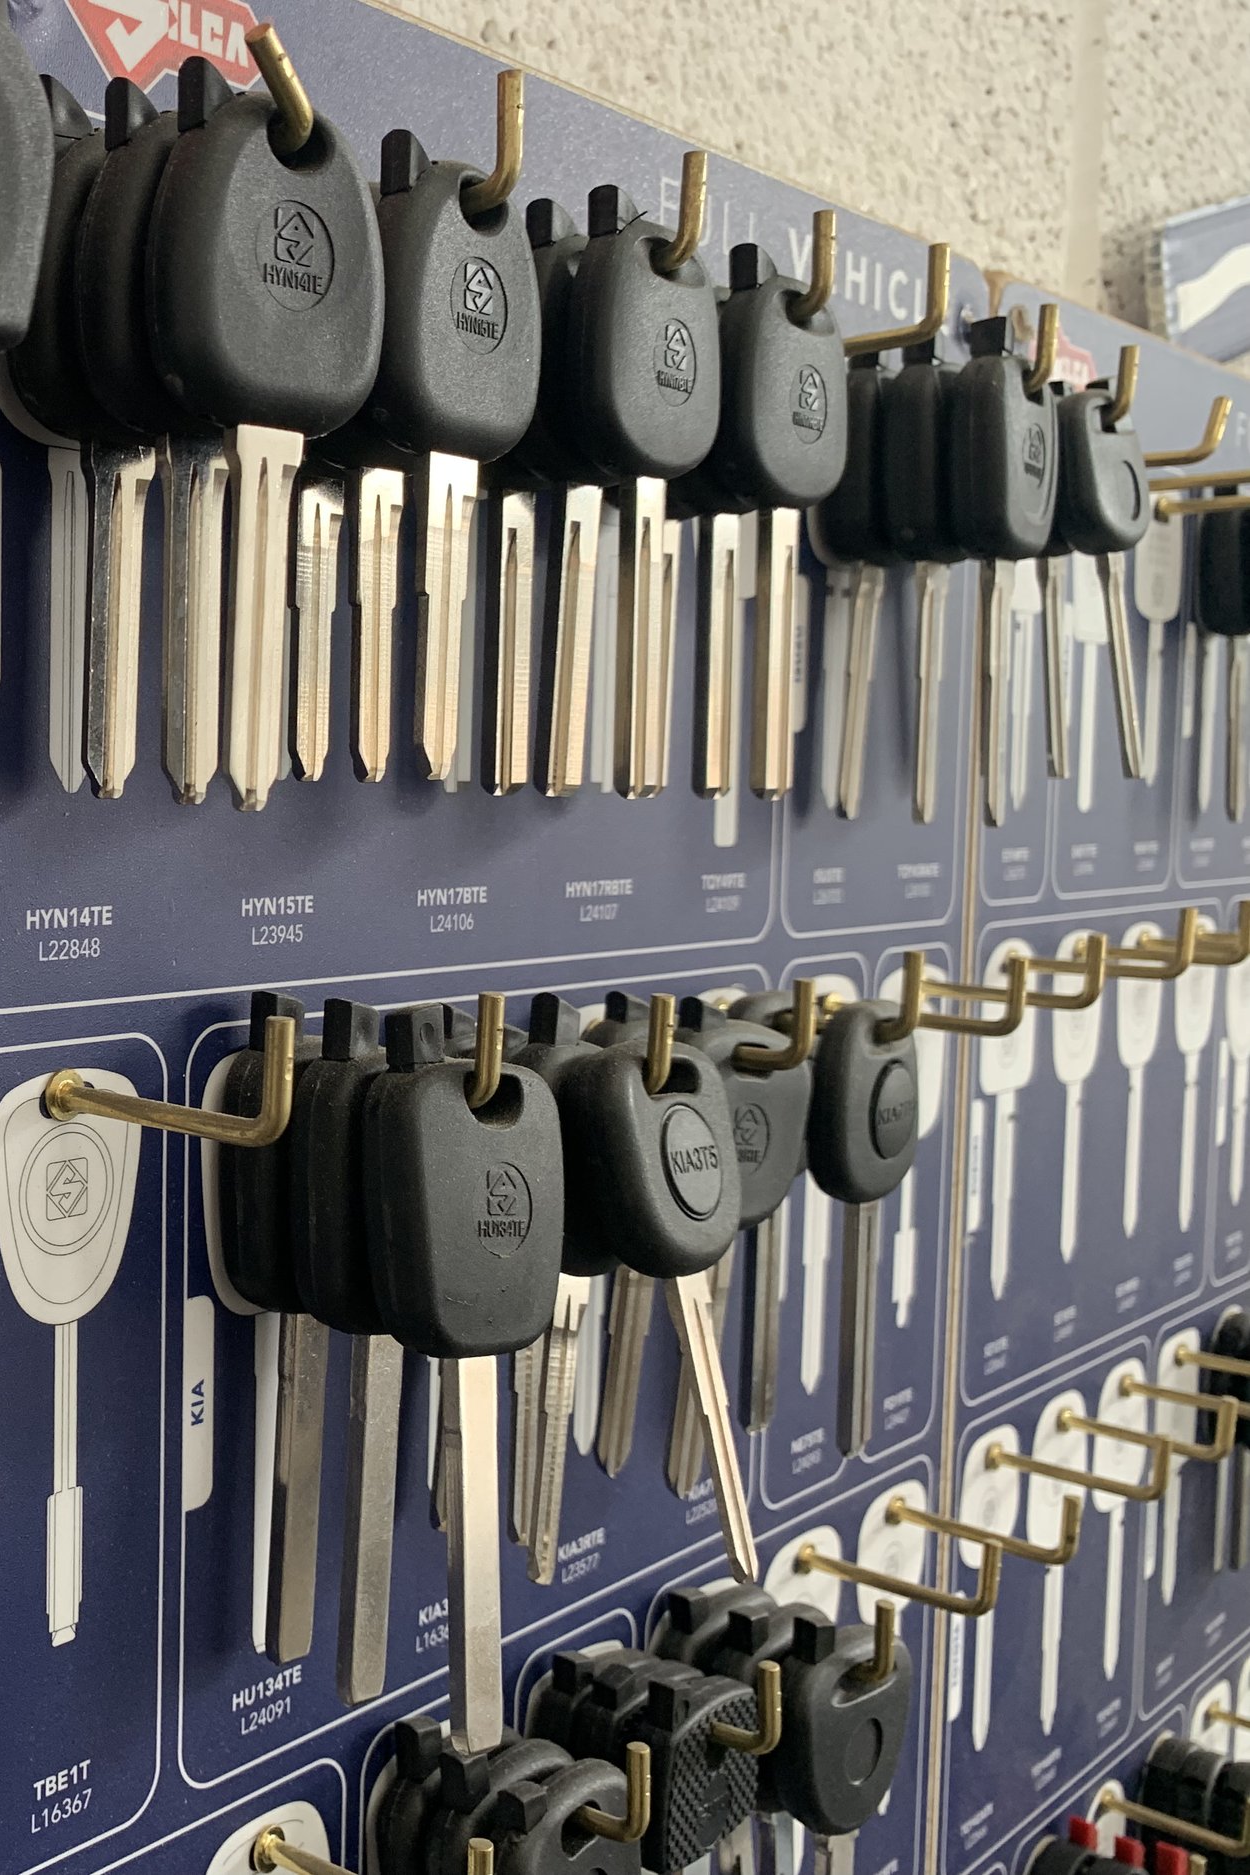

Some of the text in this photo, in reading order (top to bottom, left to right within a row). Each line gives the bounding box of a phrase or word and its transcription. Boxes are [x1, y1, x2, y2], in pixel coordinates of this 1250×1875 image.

[416, 885, 488, 908] HYN17BTE
[564, 878, 634, 899] HYN17RBTE
[25, 904, 114, 931] HYN14TE
[240, 894, 315, 918] HYN15TE
[251, 923, 304, 946] L23945
[430, 912, 475, 933] L24106
[38, 937, 102, 962] L22848
[670, 1144, 719, 1175] KIA3T5
[190, 1378, 205, 1427] KIA
[557, 1526, 606, 1564] KIA3RTE
[418, 1597, 449, 1628] KIA3
[415, 1622, 449, 1654] L1636
[231, 1664, 303, 1713] HU134TE
[240, 1695, 292, 1737] L24091
[32, 1758, 92, 1802] TBE1T
[31, 1787, 93, 1835] L16367
